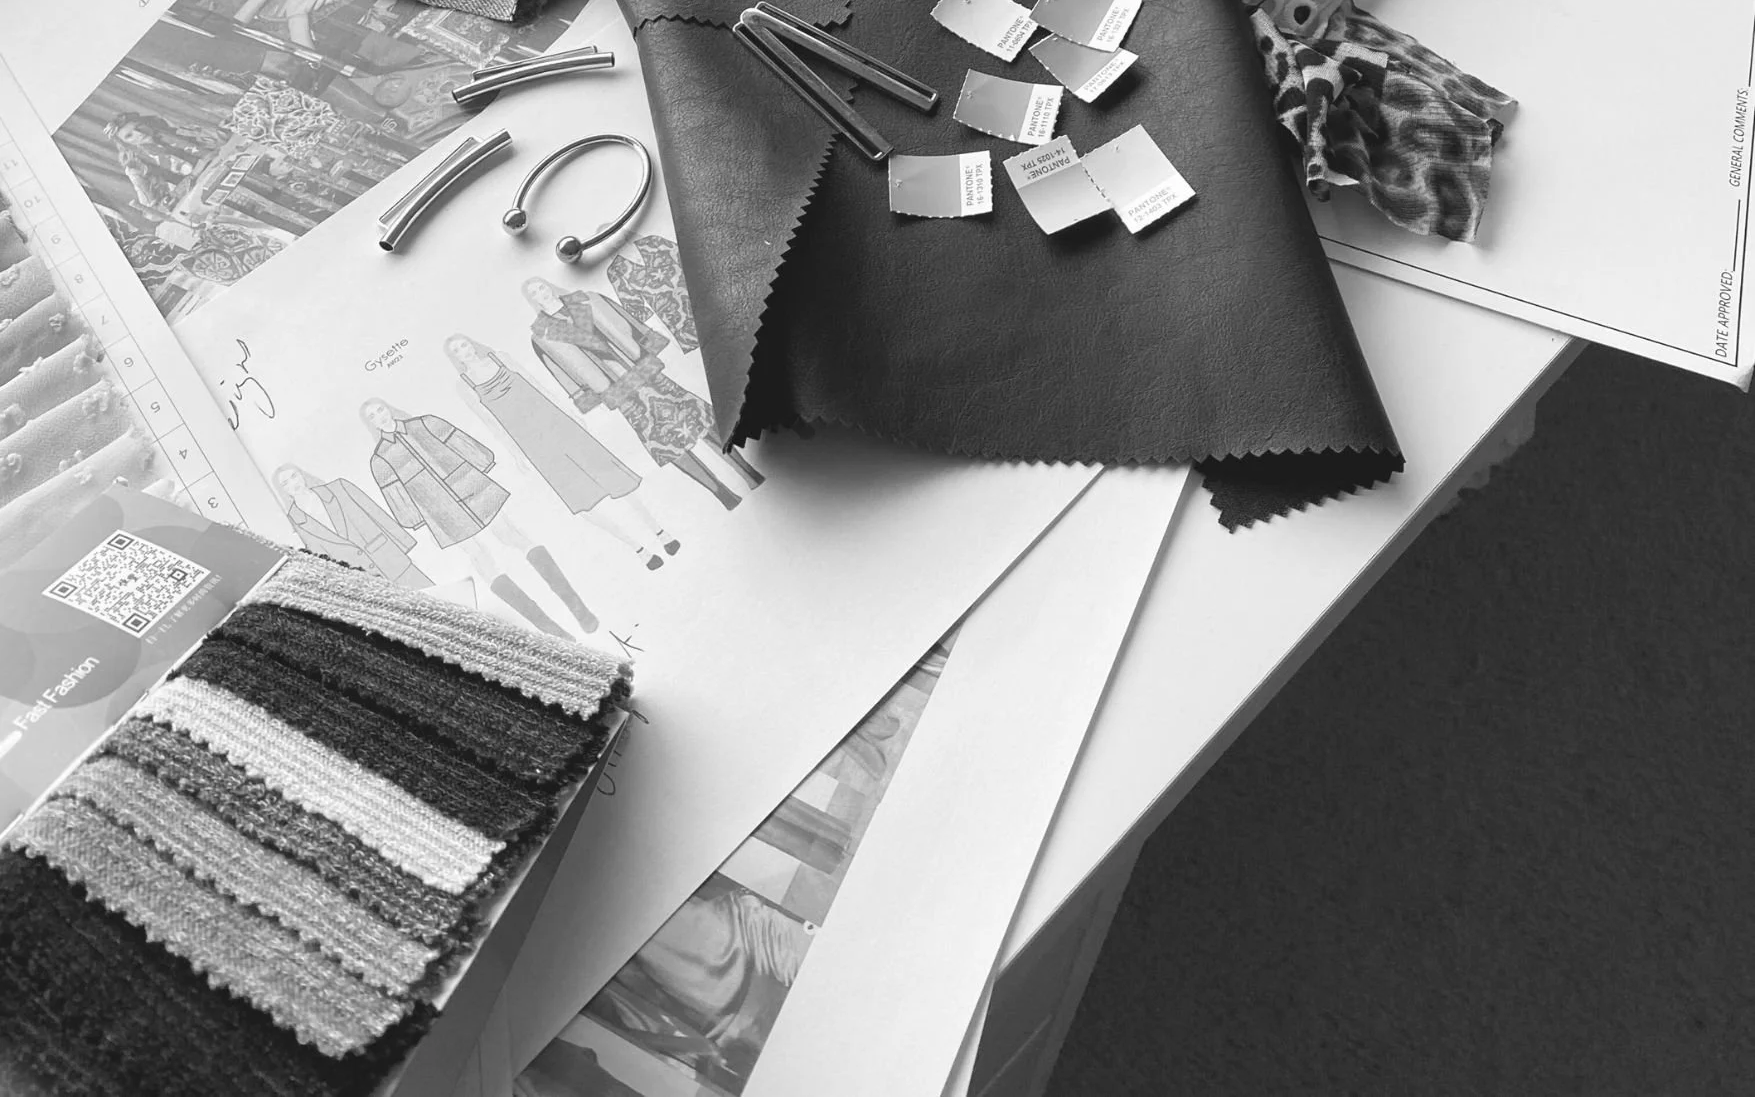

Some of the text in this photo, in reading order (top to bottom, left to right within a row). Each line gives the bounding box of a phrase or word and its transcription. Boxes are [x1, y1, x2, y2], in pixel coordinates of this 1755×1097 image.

[1728, 145, 1744, 187] GENERAL
[364, 339, 409, 371] Gysette
[1715, 329, 1728, 357] DATE
[150, 401, 161, 413] 5
[178, 449, 188, 459] 4
[208, 497, 219, 509] 3
[13, 656, 100, 730] Fast Fashion
